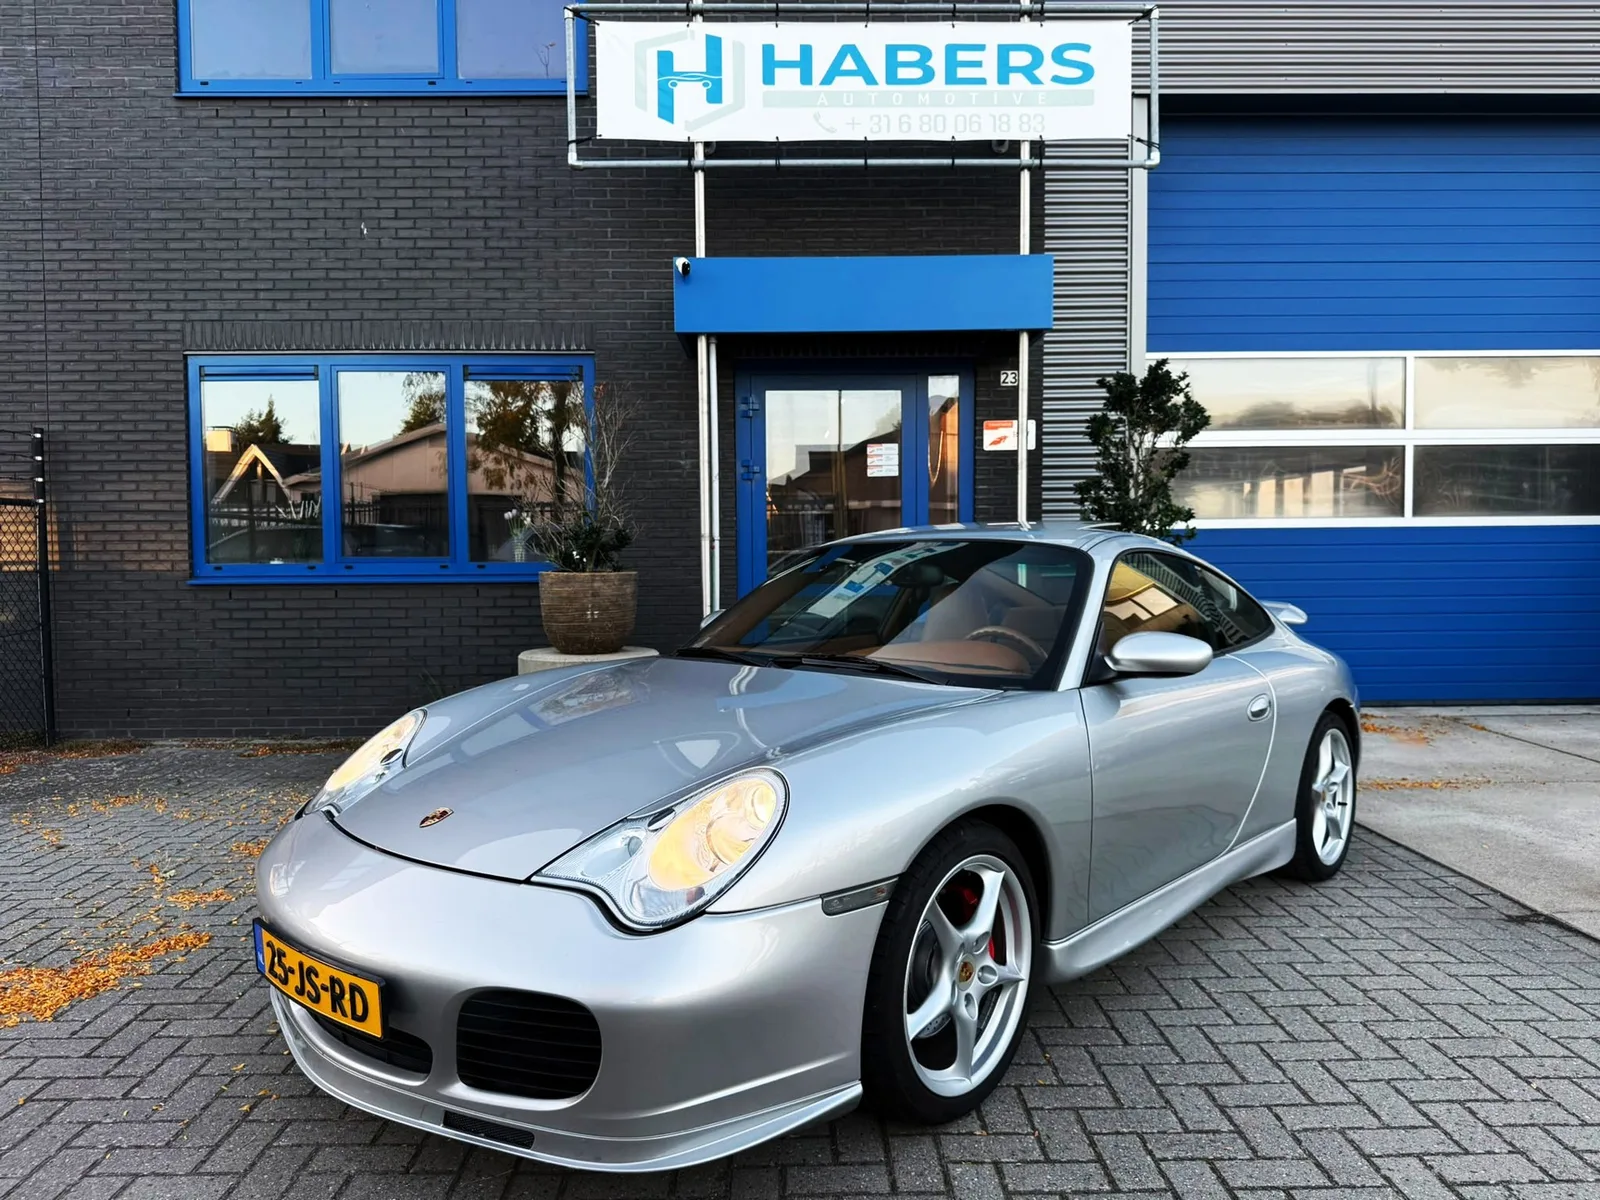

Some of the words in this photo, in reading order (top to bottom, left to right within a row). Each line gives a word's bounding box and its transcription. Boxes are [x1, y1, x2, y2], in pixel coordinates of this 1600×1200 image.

[762, 43, 1095, 86] HABERS
[817, 92, 1047, 106] AUTOMOTIVE
[869, 114, 891, 134] 31
[899, 115, 912, 134] 6
[919, 114, 946, 134] 80
[954, 113, 982, 133] 06
[989, 113, 1011, 133] 18
[1019, 113, 1046, 133] 83
[1001, 372, 1018, 385] 23
[266, 940, 369, 1023] 25-JS-RD
